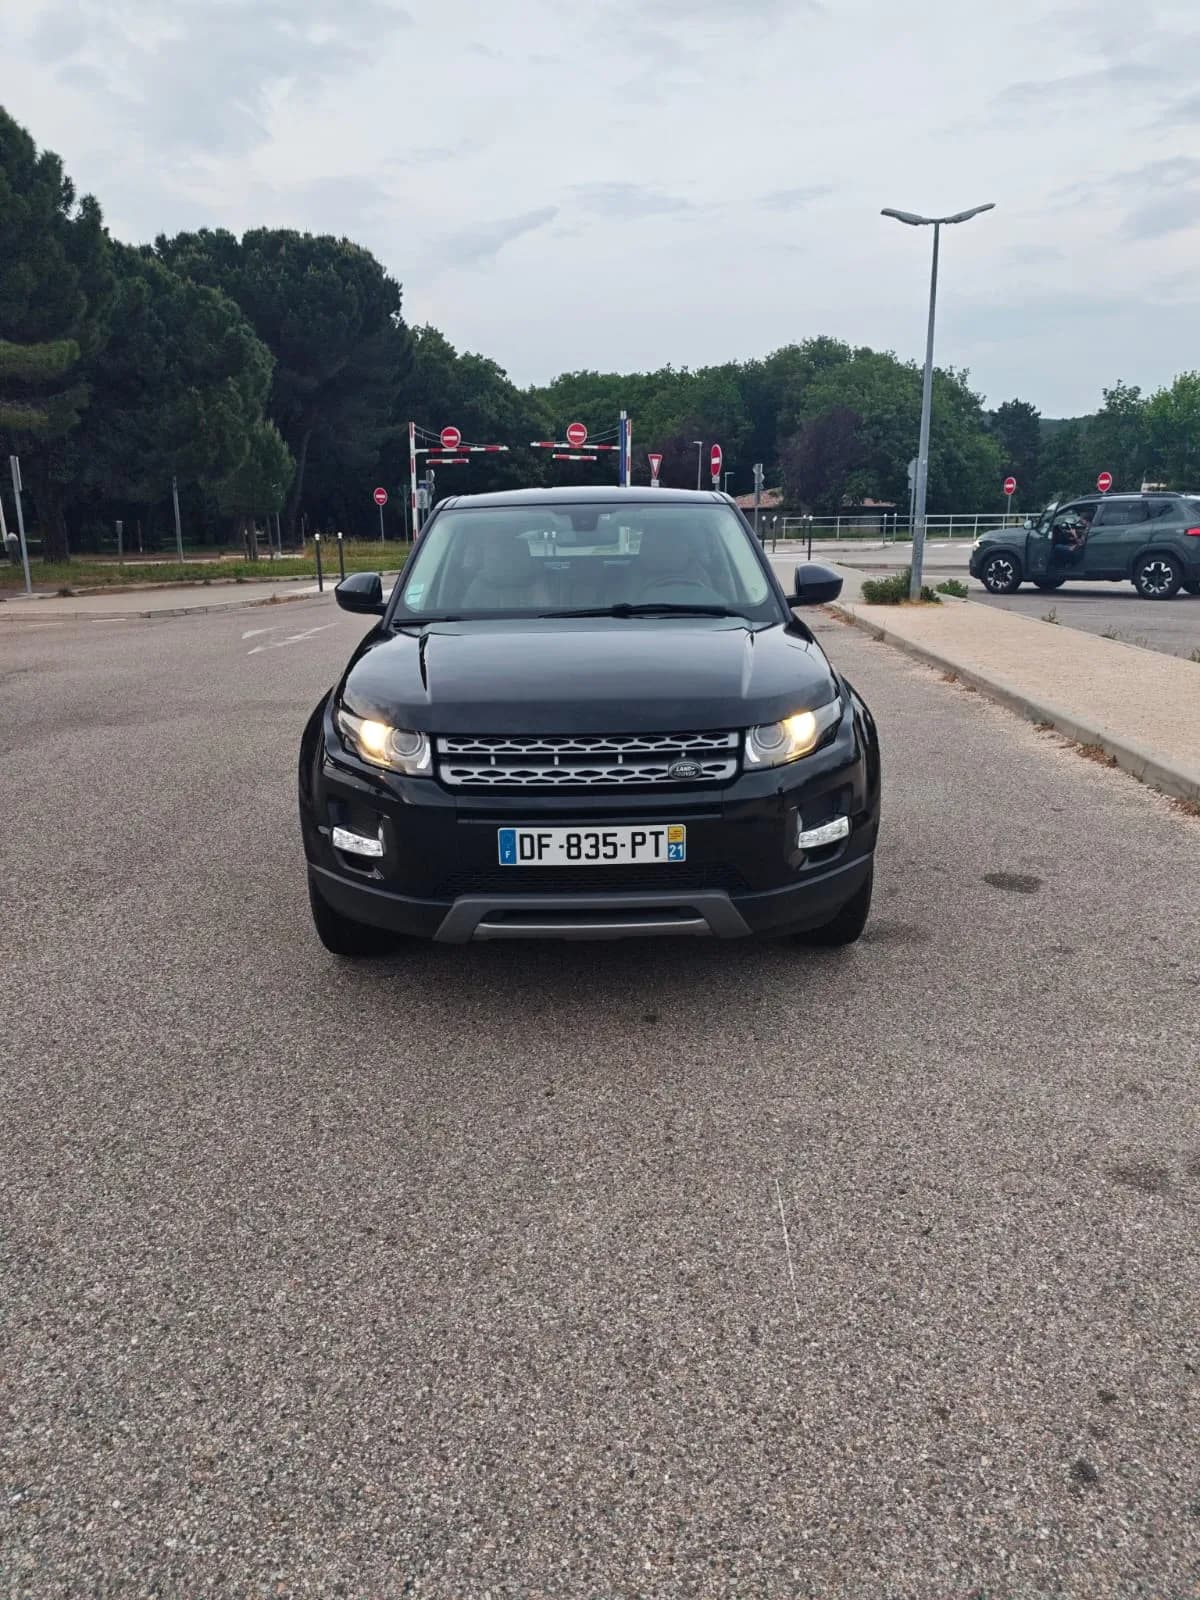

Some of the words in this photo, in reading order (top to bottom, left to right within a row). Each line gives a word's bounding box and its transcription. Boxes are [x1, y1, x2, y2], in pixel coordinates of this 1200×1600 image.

[519, 831, 665, 860] DF-835-PT
[668, 843, 683, 858] 21
[505, 850, 511, 859] F
